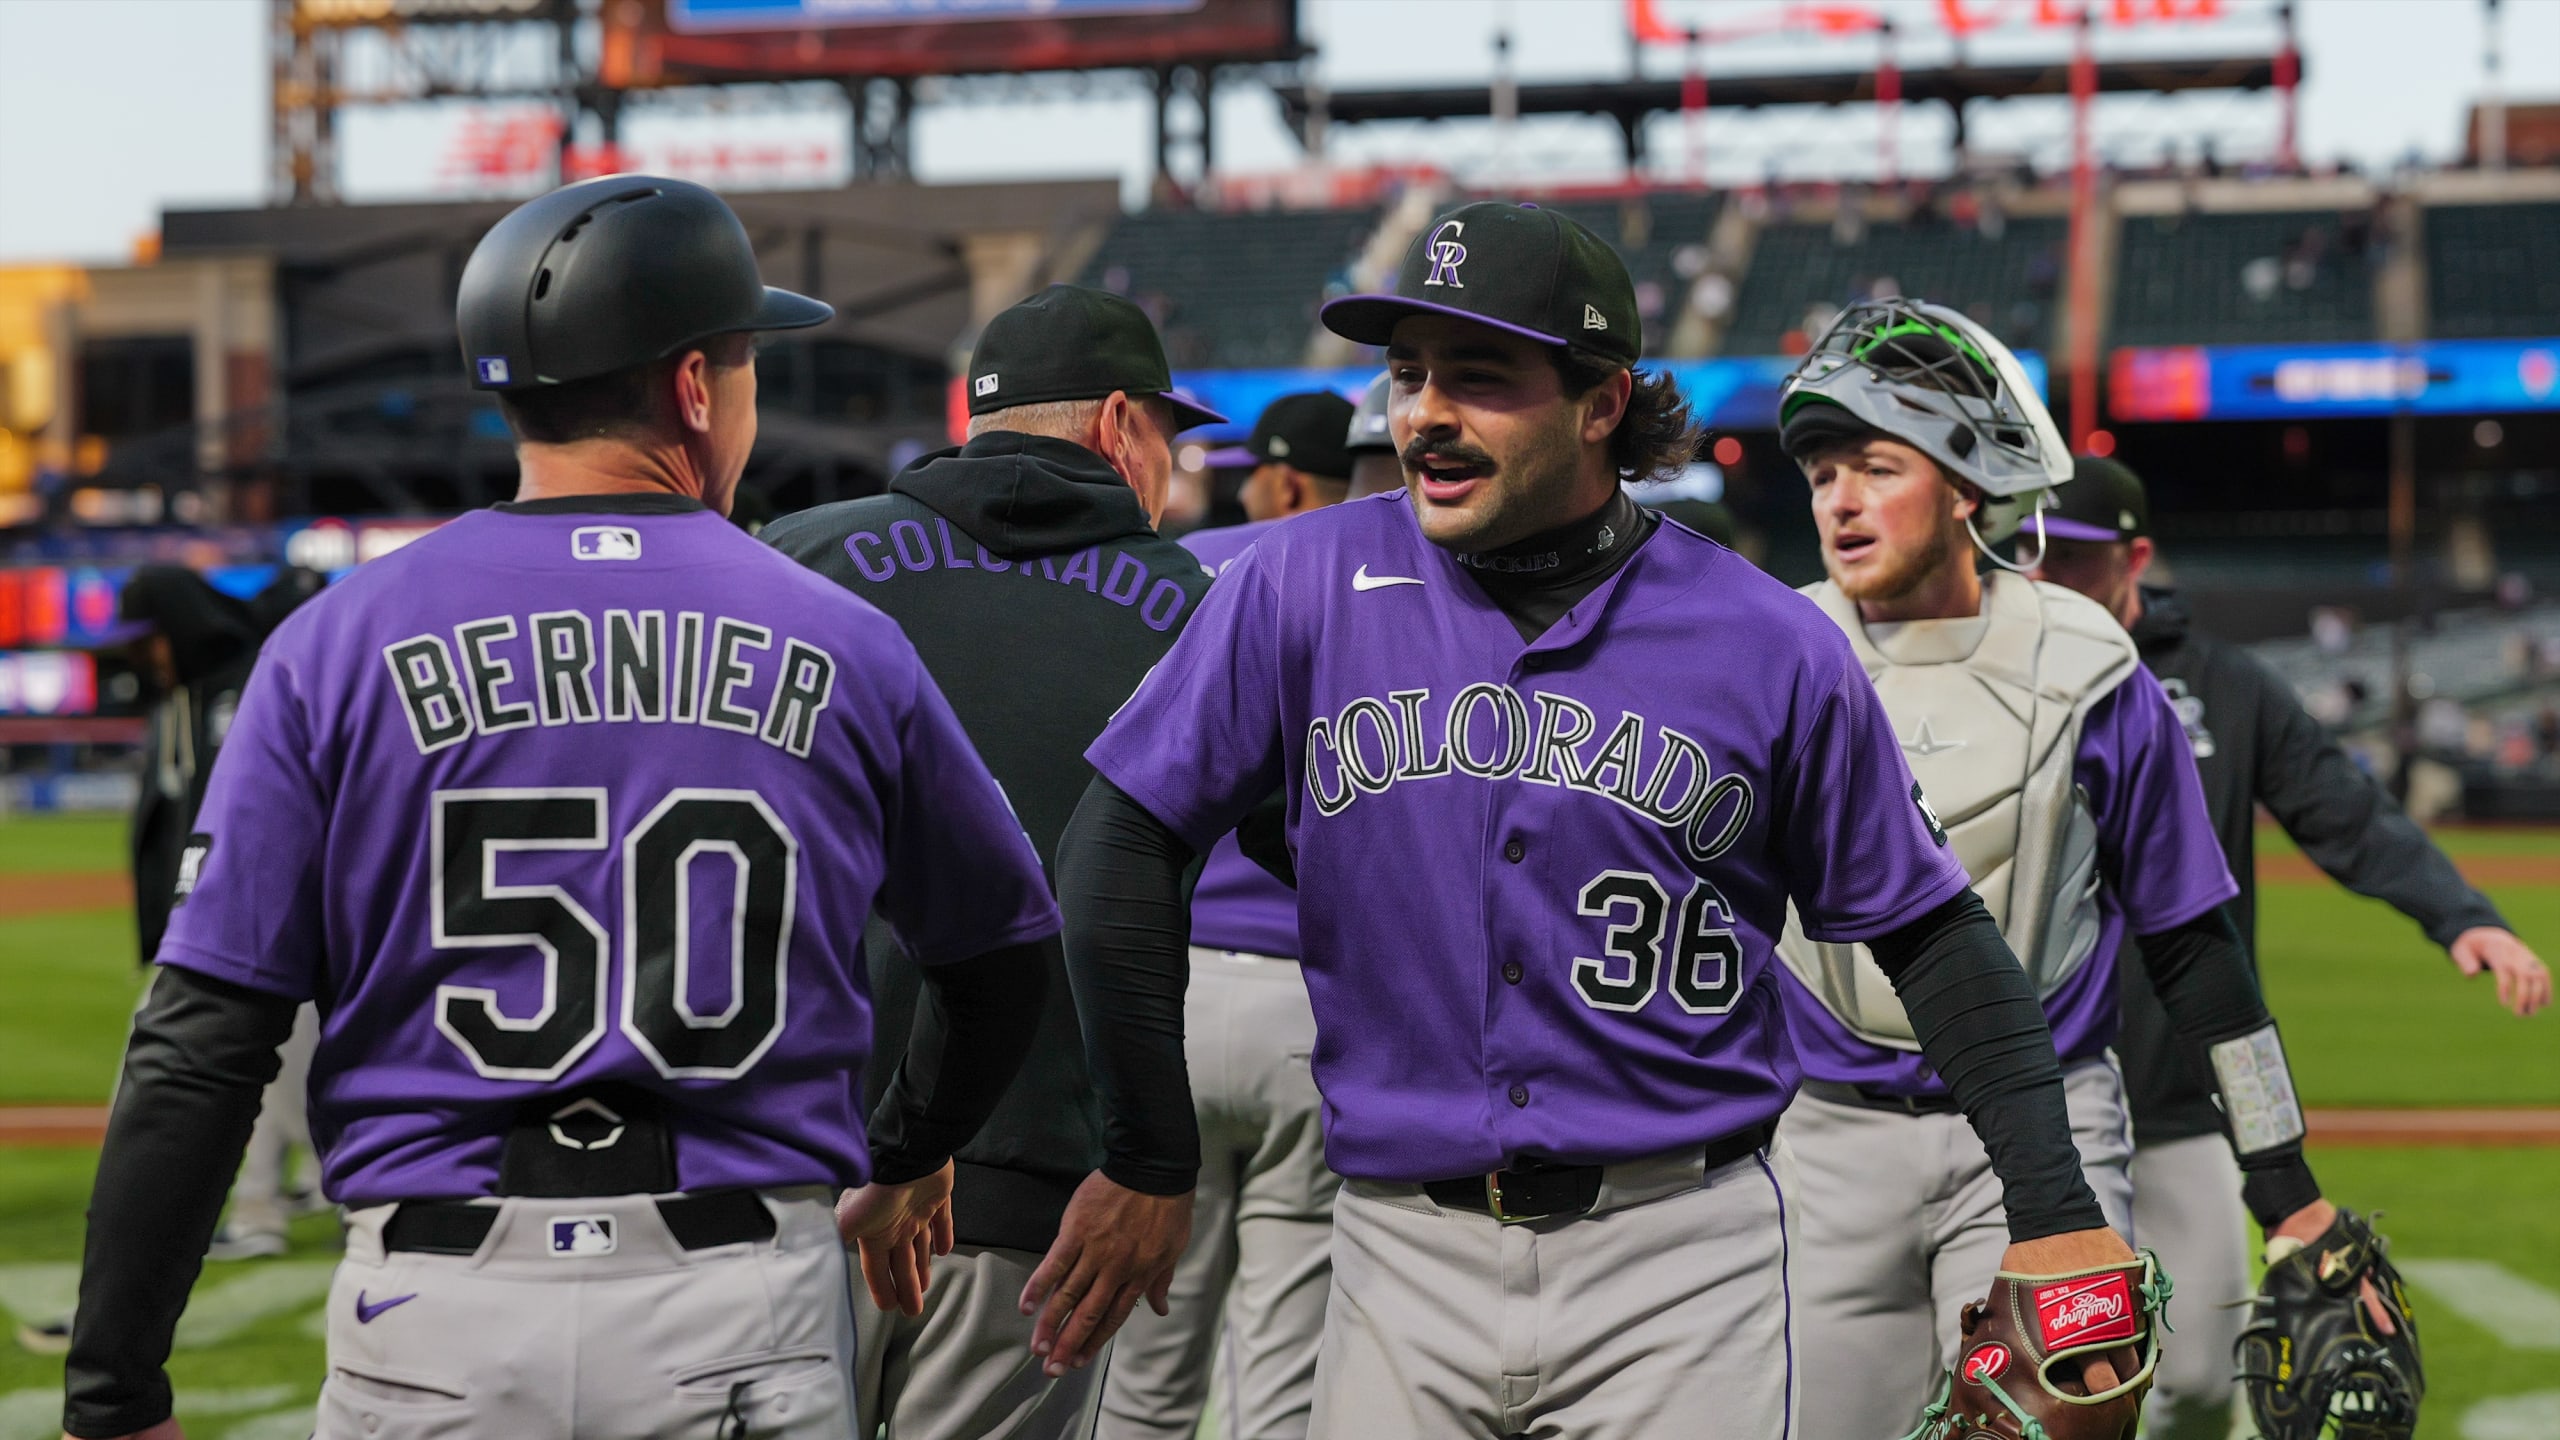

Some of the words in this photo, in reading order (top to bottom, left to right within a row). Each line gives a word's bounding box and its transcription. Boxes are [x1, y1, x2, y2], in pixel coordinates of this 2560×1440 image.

[1424, 220, 1467, 288] CR
[843, 517, 1186, 631] COLADO
[383, 609, 836, 758] BERNIER
[1306, 682, 1753, 861] COLORADO
[430, 787, 799, 1081] 50
[1570, 869, 1744, 1014] 36
[2049, 1293, 2122, 1330] Rawlings
